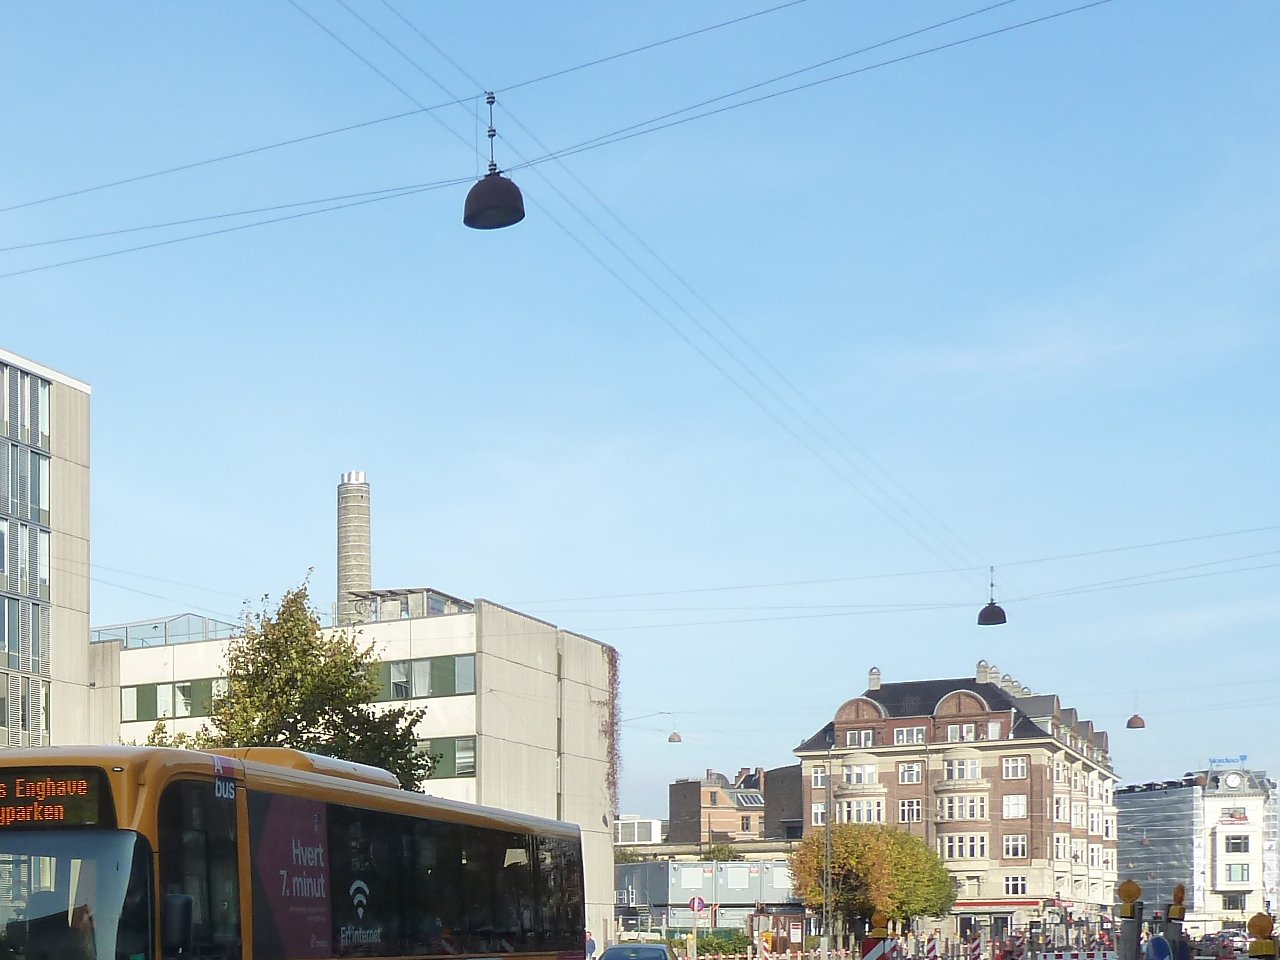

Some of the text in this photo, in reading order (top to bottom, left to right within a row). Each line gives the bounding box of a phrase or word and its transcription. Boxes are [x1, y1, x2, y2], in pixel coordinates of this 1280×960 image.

[15, 777, 88, 801] Enghave
[215, 777, 235, 799] bus
[291, 838, 325, 867] Hvert
[280, 870, 326, 898] 7. minut
